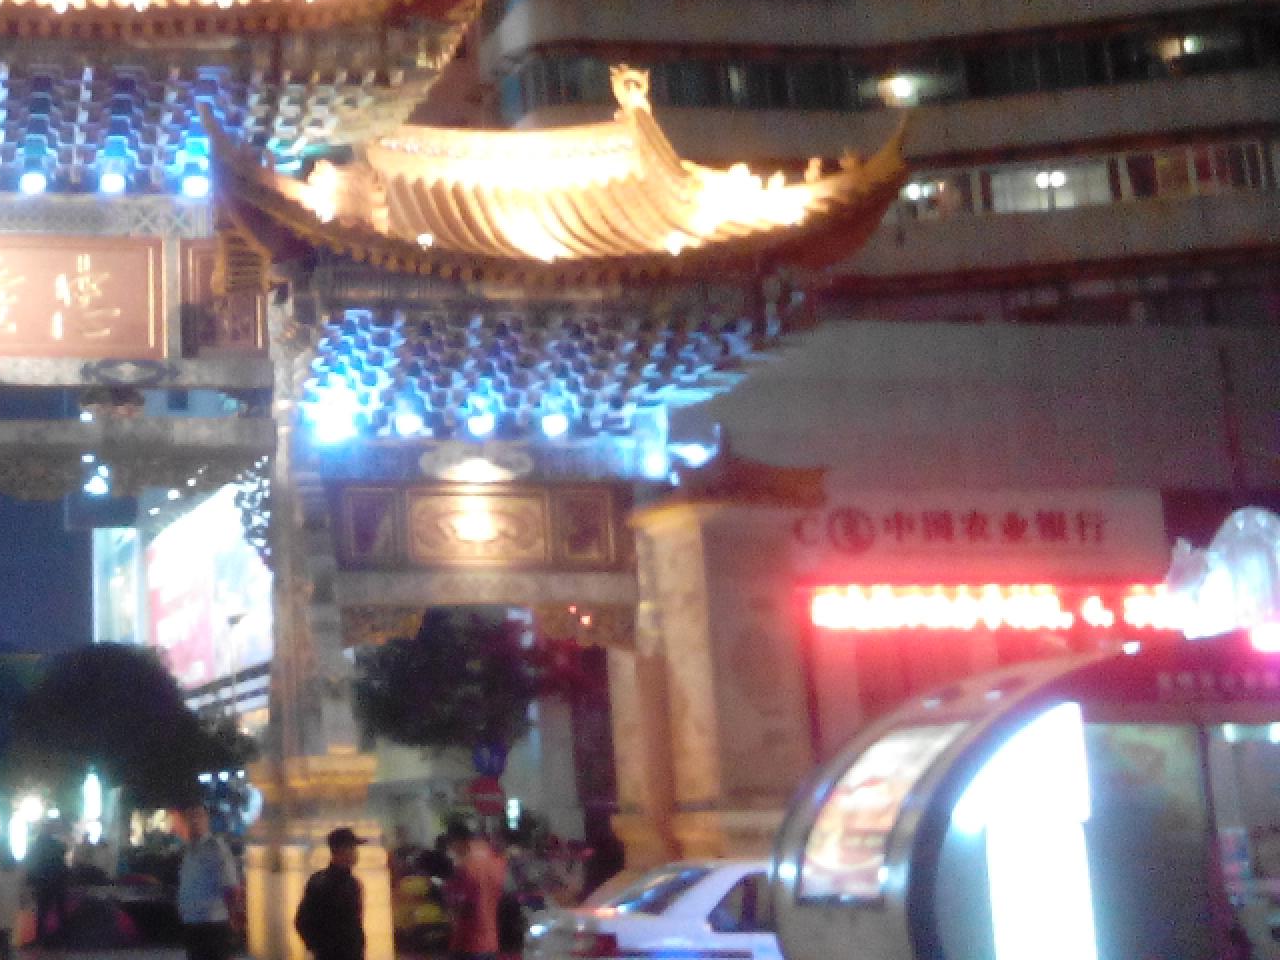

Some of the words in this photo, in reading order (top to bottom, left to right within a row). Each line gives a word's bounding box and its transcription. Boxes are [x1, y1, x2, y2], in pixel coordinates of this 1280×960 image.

[882, 508, 1107, 543] 中国农业银行
